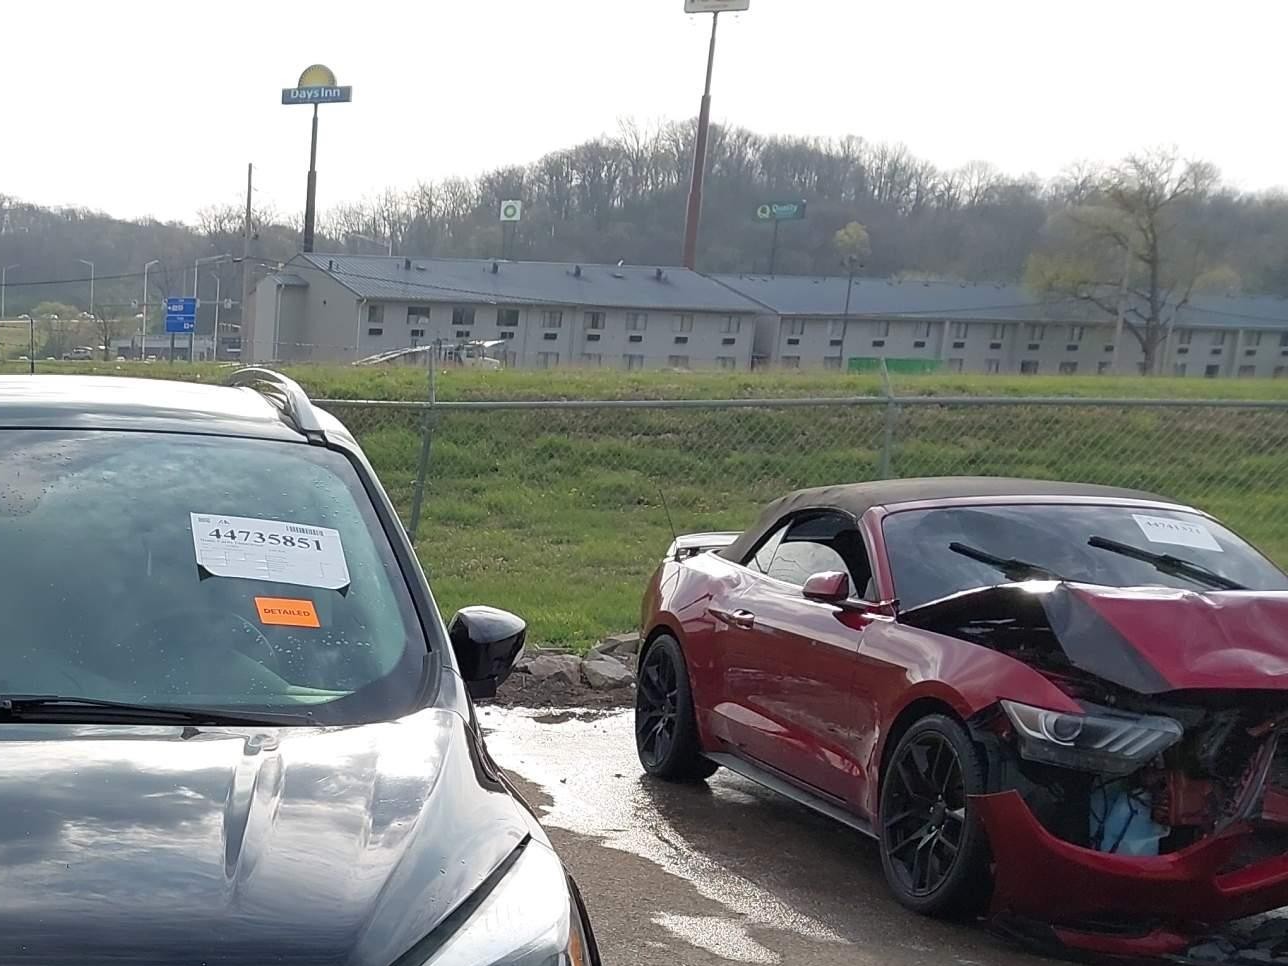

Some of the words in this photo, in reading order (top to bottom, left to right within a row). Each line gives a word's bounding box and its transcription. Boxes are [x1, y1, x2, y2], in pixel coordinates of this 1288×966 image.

[290, 88, 319, 99] Days
[320, 87, 341, 97] Inn
[208, 528, 323, 551] 44735851
[263, 607, 312, 617] DETAILED
